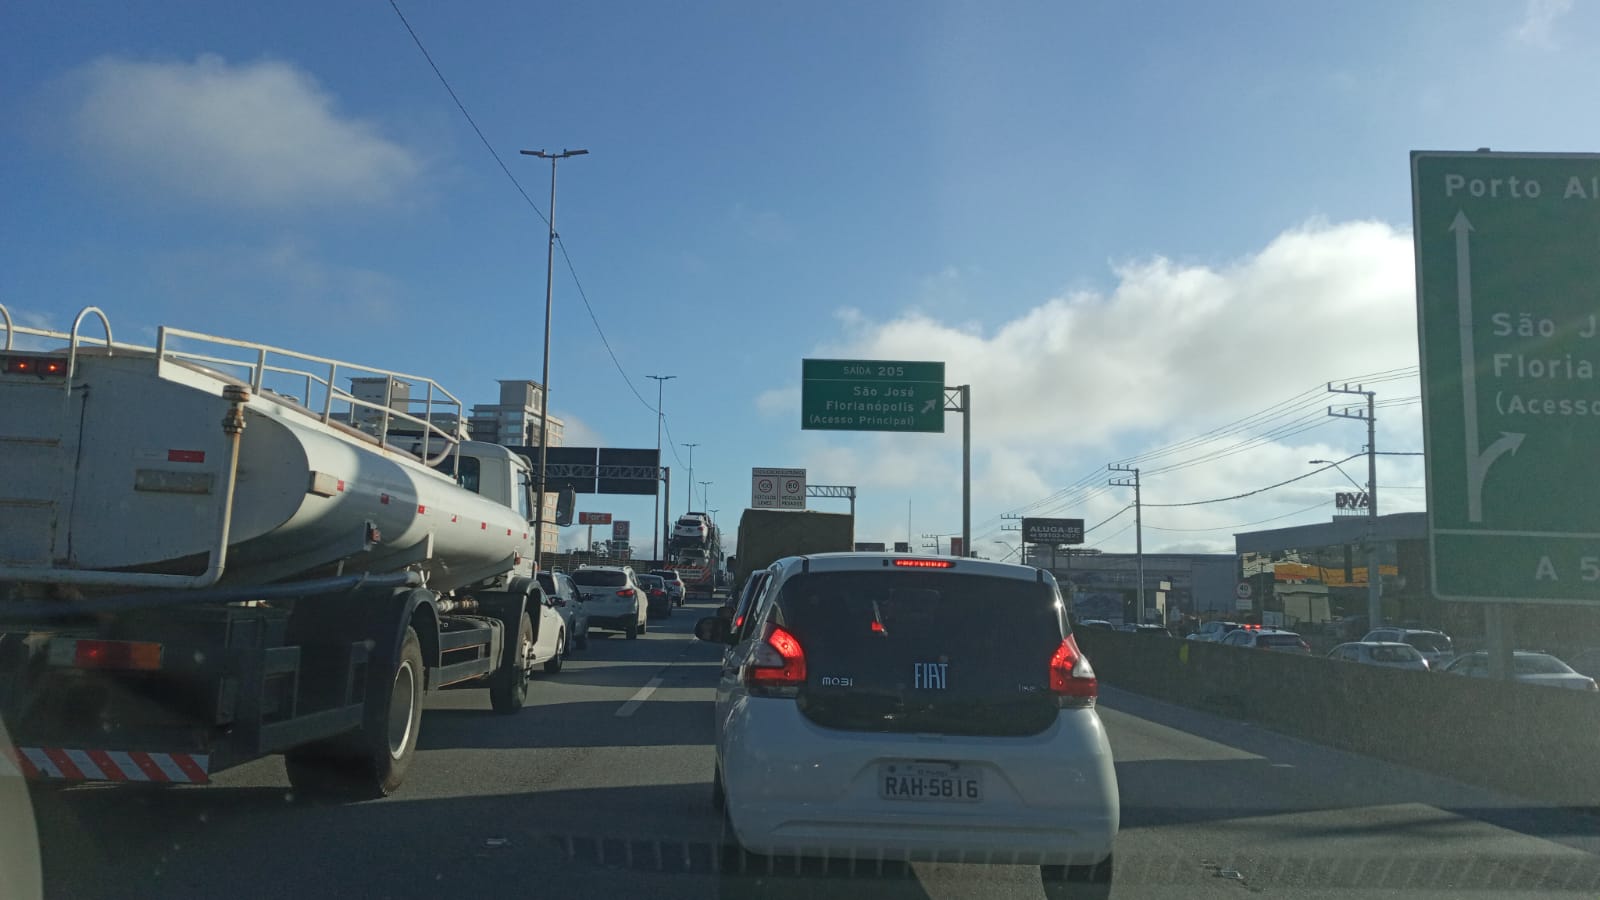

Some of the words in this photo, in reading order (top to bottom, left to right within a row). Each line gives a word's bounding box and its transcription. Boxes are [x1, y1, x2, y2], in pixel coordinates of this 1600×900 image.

[1445, 174, 1542, 199] Porto
[1563, 175, 1599, 200] Al
[1491, 312, 1554, 337] São
[1578, 314, 1597, 338] J
[843, 364, 871, 375] SAÍDA
[878, 366, 904, 377] 205
[1493, 353, 1593, 380] Floria
[853, 386, 878, 397] São
[884, 386, 915, 398] José
[826, 400, 915, 413] Florianópolis
[809, 415, 854, 425] (Acesso
[859, 416, 915, 427] Principal)
[1535, 555, 1559, 580] A
[1580, 556, 1600, 581] 5
[822, 676, 853, 687] MOBI
[914, 662, 949, 690] FIAT
